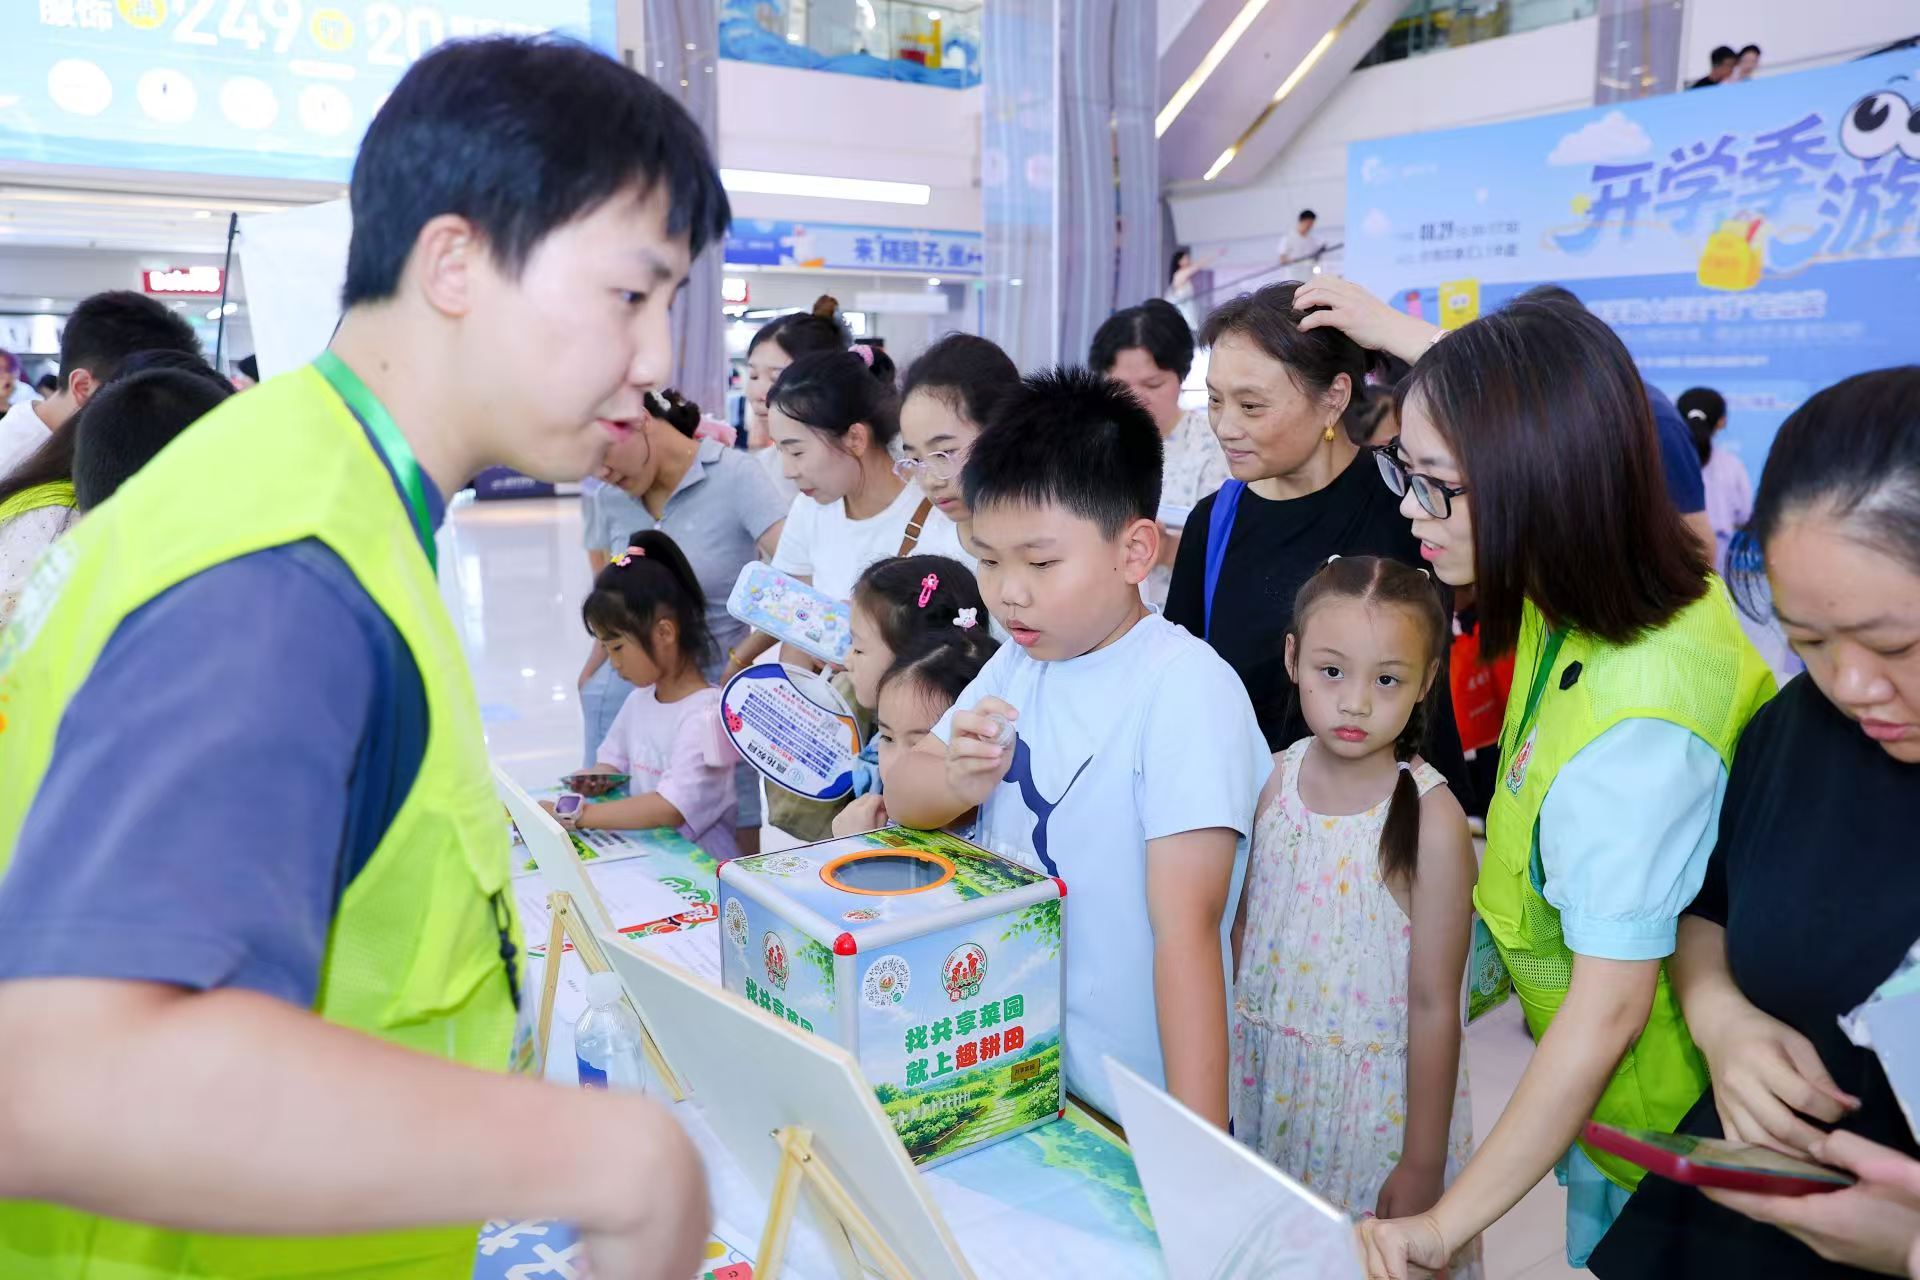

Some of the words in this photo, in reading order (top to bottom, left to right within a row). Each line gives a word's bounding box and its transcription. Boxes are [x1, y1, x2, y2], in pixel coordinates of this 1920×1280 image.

[1562, 113, 1838, 254] 开学季
[904, 993, 1025, 1054] 找共享菜园
[905, 1025, 1025, 1087] 就上趣耕田
